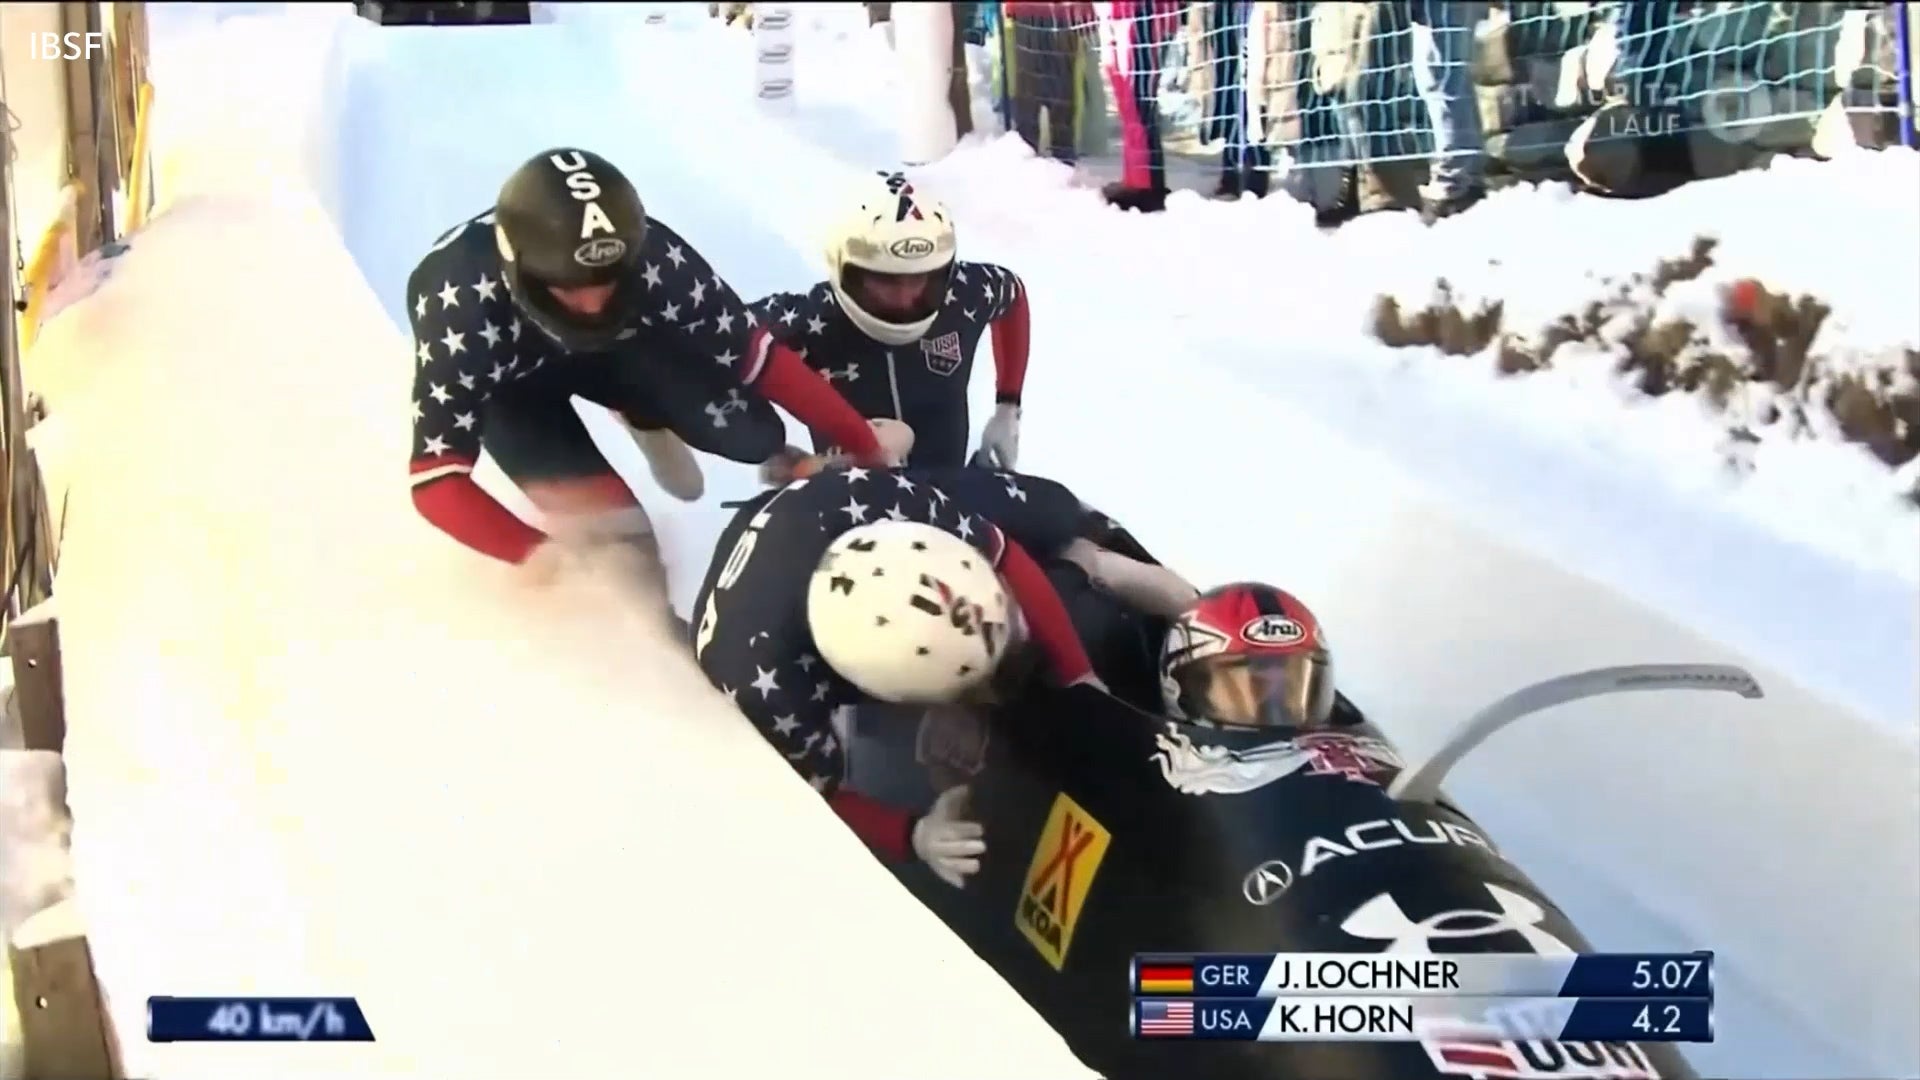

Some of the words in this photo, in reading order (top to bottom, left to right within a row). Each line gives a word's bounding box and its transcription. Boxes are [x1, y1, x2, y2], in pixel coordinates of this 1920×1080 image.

[550, 151, 616, 239] USA
[1249, 619, 1299, 637] Arai
[1301, 818, 1504, 876] ACUR
